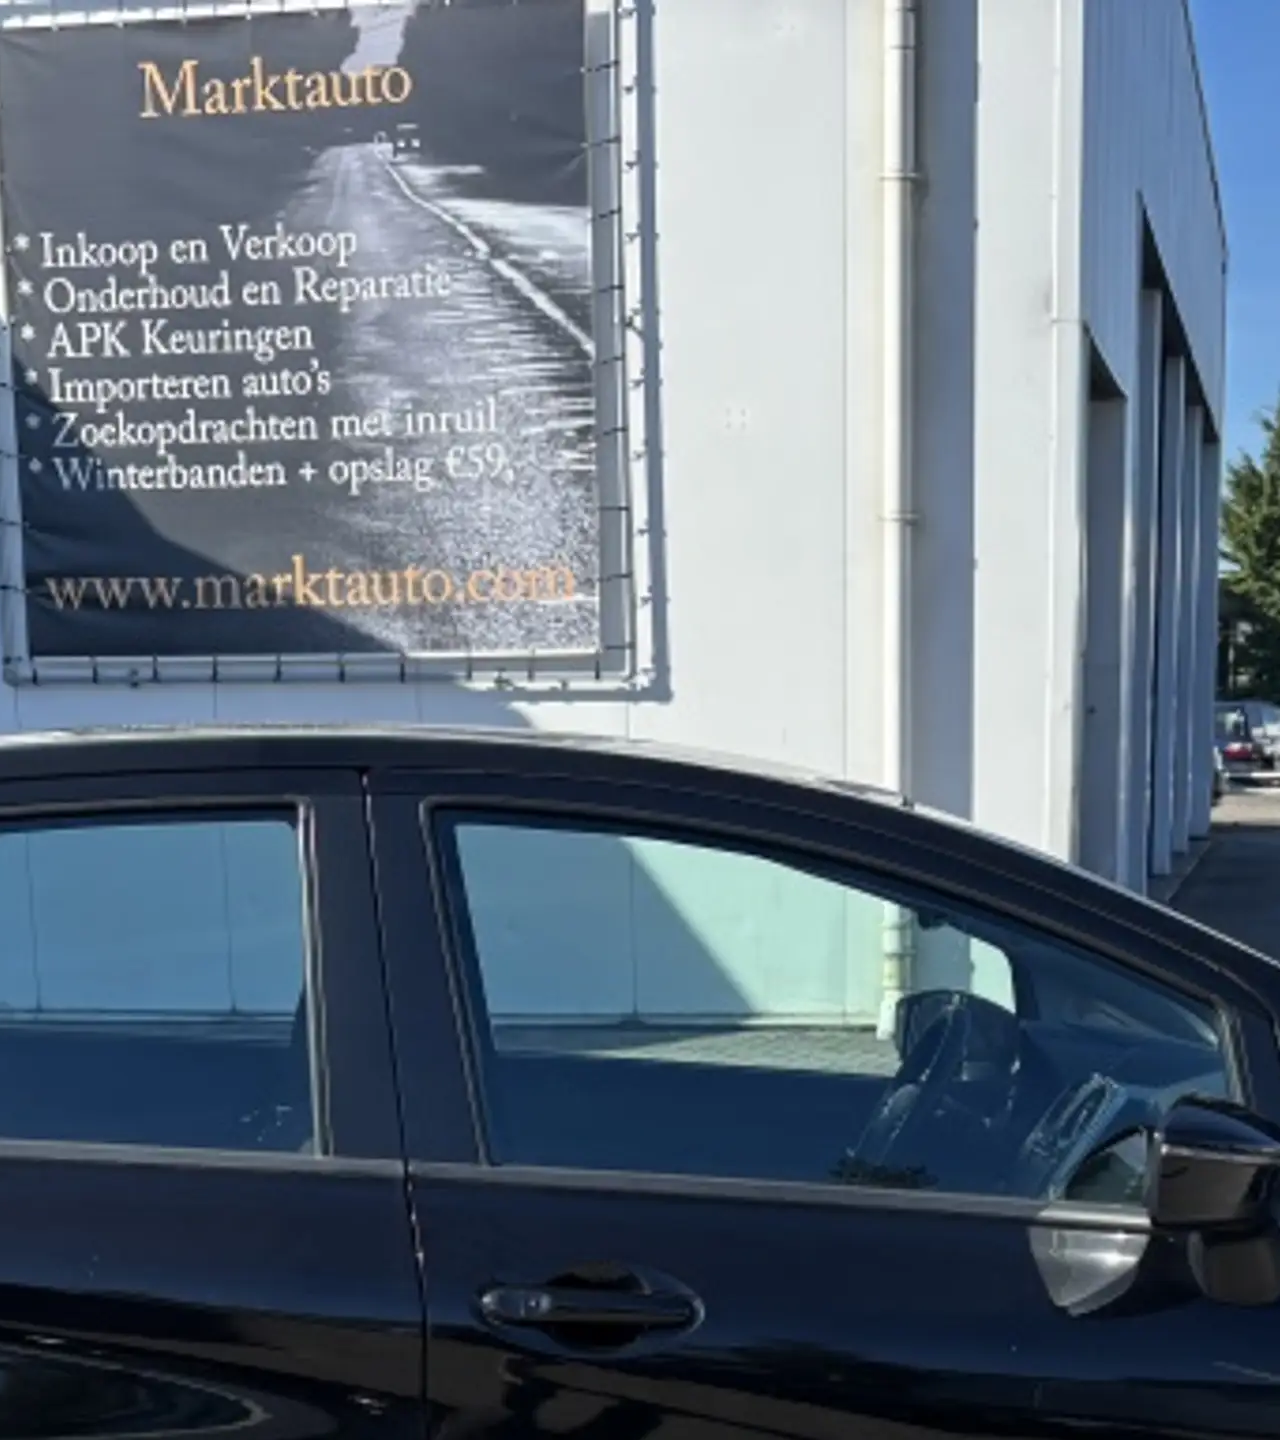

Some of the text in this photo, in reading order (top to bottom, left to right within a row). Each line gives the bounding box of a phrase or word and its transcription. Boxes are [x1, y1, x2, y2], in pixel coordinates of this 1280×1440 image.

[137, 56, 413, 117] Marktauto
[40, 222, 357, 277] Inkoop en Verkoop
[43, 262, 452, 314] Onderhoud en Reparatie
[46, 317, 315, 365] APK Keuringen
[48, 357, 332, 414] Importeren auto's
[52, 394, 499, 456] Zoekopdrachten met inruil
[52, 450, 287, 492] Winterbanden
[328, 446, 435, 497] opslag
[45, 553, 576, 612] www.marktauto.com
